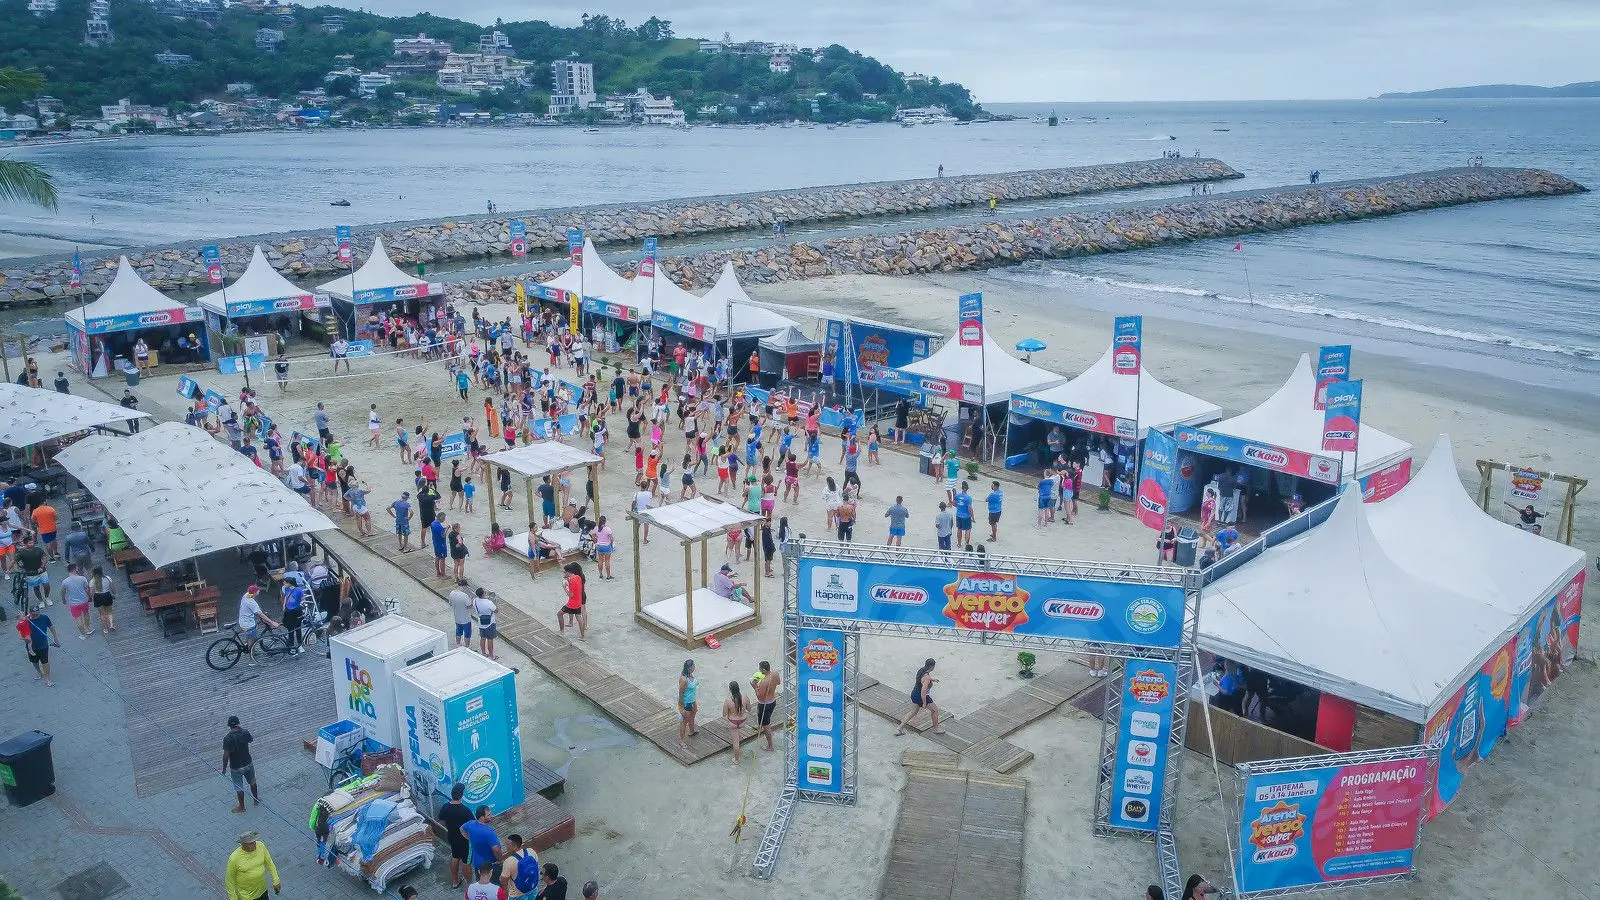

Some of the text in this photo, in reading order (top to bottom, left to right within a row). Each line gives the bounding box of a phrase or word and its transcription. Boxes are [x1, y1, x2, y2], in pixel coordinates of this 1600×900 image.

[1019, 400, 1038, 409] play
[1074, 414, 1094, 426] koch
[1187, 433, 1211, 444] play
[1257, 451, 1284, 464] koch
[958, 578, 1014, 592] Arena
[815, 589, 855, 601] Itapema
[889, 587, 923, 602] koch
[947, 592, 1025, 613] verão
[1063, 602, 1099, 617] koch
[1137, 675, 1163, 683] Arena
[457, 714, 490, 732] MASCULINO
[458, 710, 489, 727] SANITÁRIO
[1341, 765, 1417, 788] PROGRAMAÇÃO
[1269, 782, 1304, 793] ITAPEMA
[1259, 793, 1269, 801] 05
[1287, 788, 1315, 798] Janeiro
[1261, 810, 1297, 823] Arena
[1254, 820, 1303, 838] verão
[1267, 847, 1294, 858] koch
